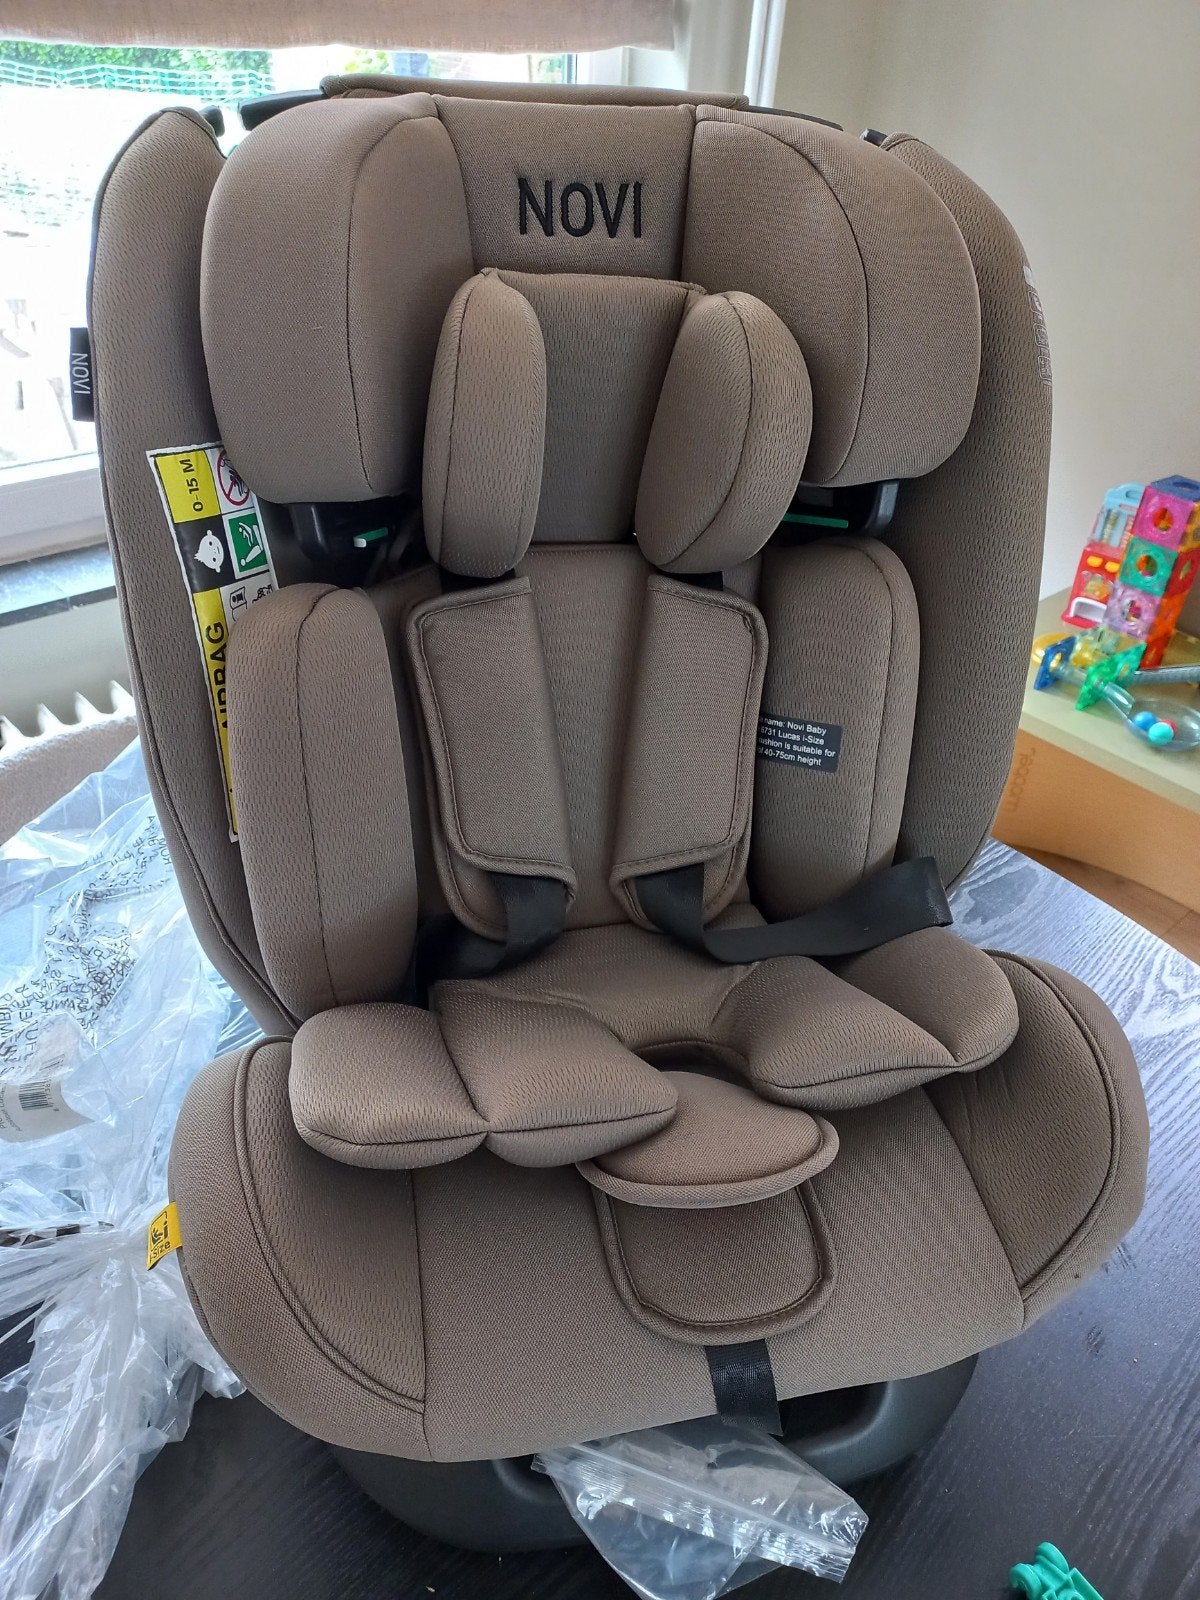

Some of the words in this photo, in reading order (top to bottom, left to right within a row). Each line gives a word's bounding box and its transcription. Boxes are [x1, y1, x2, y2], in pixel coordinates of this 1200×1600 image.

[518, 177, 642, 238] NOVI
[72, 352, 91, 394] NOVI
[179, 459, 195, 474] M
[186, 477, 204, 512] 0-15
[205, 622, 227, 728] BAG
[787, 721, 805, 731] Novi
[806, 725, 827, 736] Baby
[778, 730, 801, 741] Lucas
[803, 735, 824, 745] i-Size
[765, 749, 796, 760] 40-75cm
[797, 755, 822, 766] height
[785, 742, 791, 750] is
[793, 745, 822, 755] suitable
[825, 749, 836, 757] for
